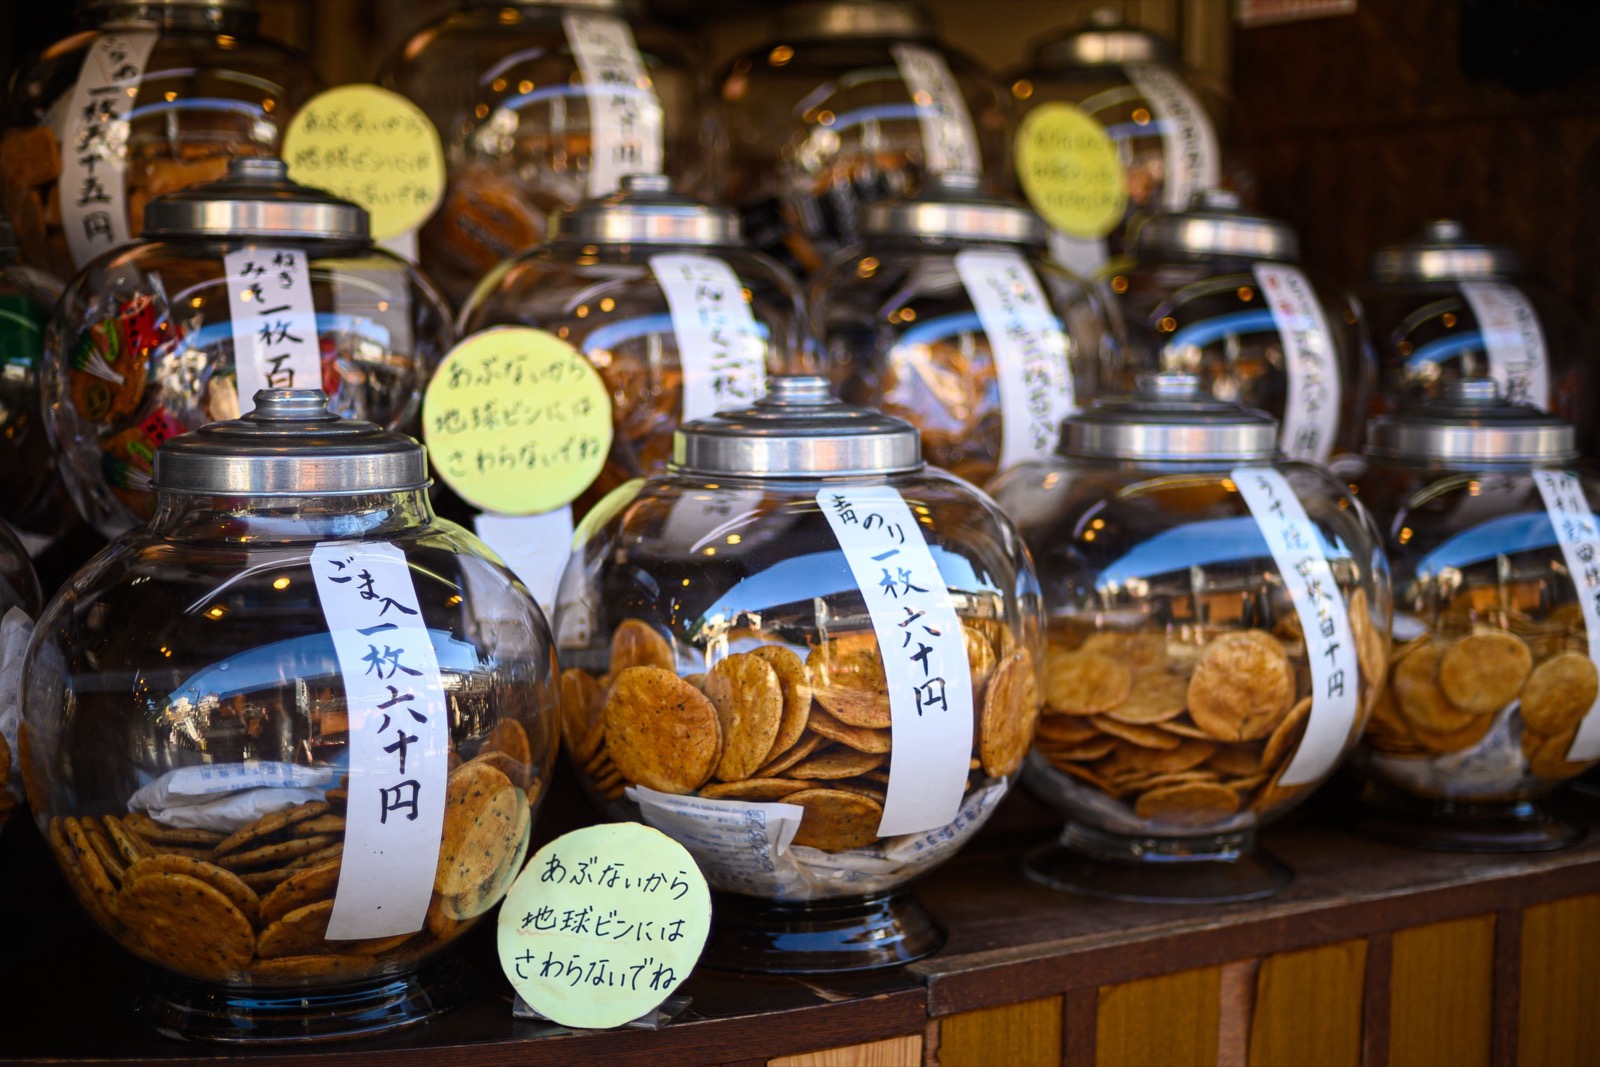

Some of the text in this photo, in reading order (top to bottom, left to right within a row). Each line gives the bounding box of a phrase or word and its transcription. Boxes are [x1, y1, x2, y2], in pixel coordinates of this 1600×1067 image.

[448, 354, 588, 389] あぶないから
[435, 398, 594, 435] 地球ビンには
[447, 435, 602, 478] さわらないでね
[831, 493, 948, 717] 青のり一枚六十円
[327, 556, 428, 825] ごま入一枚六十円
[540, 853, 690, 901] あぶないから
[521, 904, 687, 942] 地球ビンには
[514, 948, 678, 991] さわらないでね
